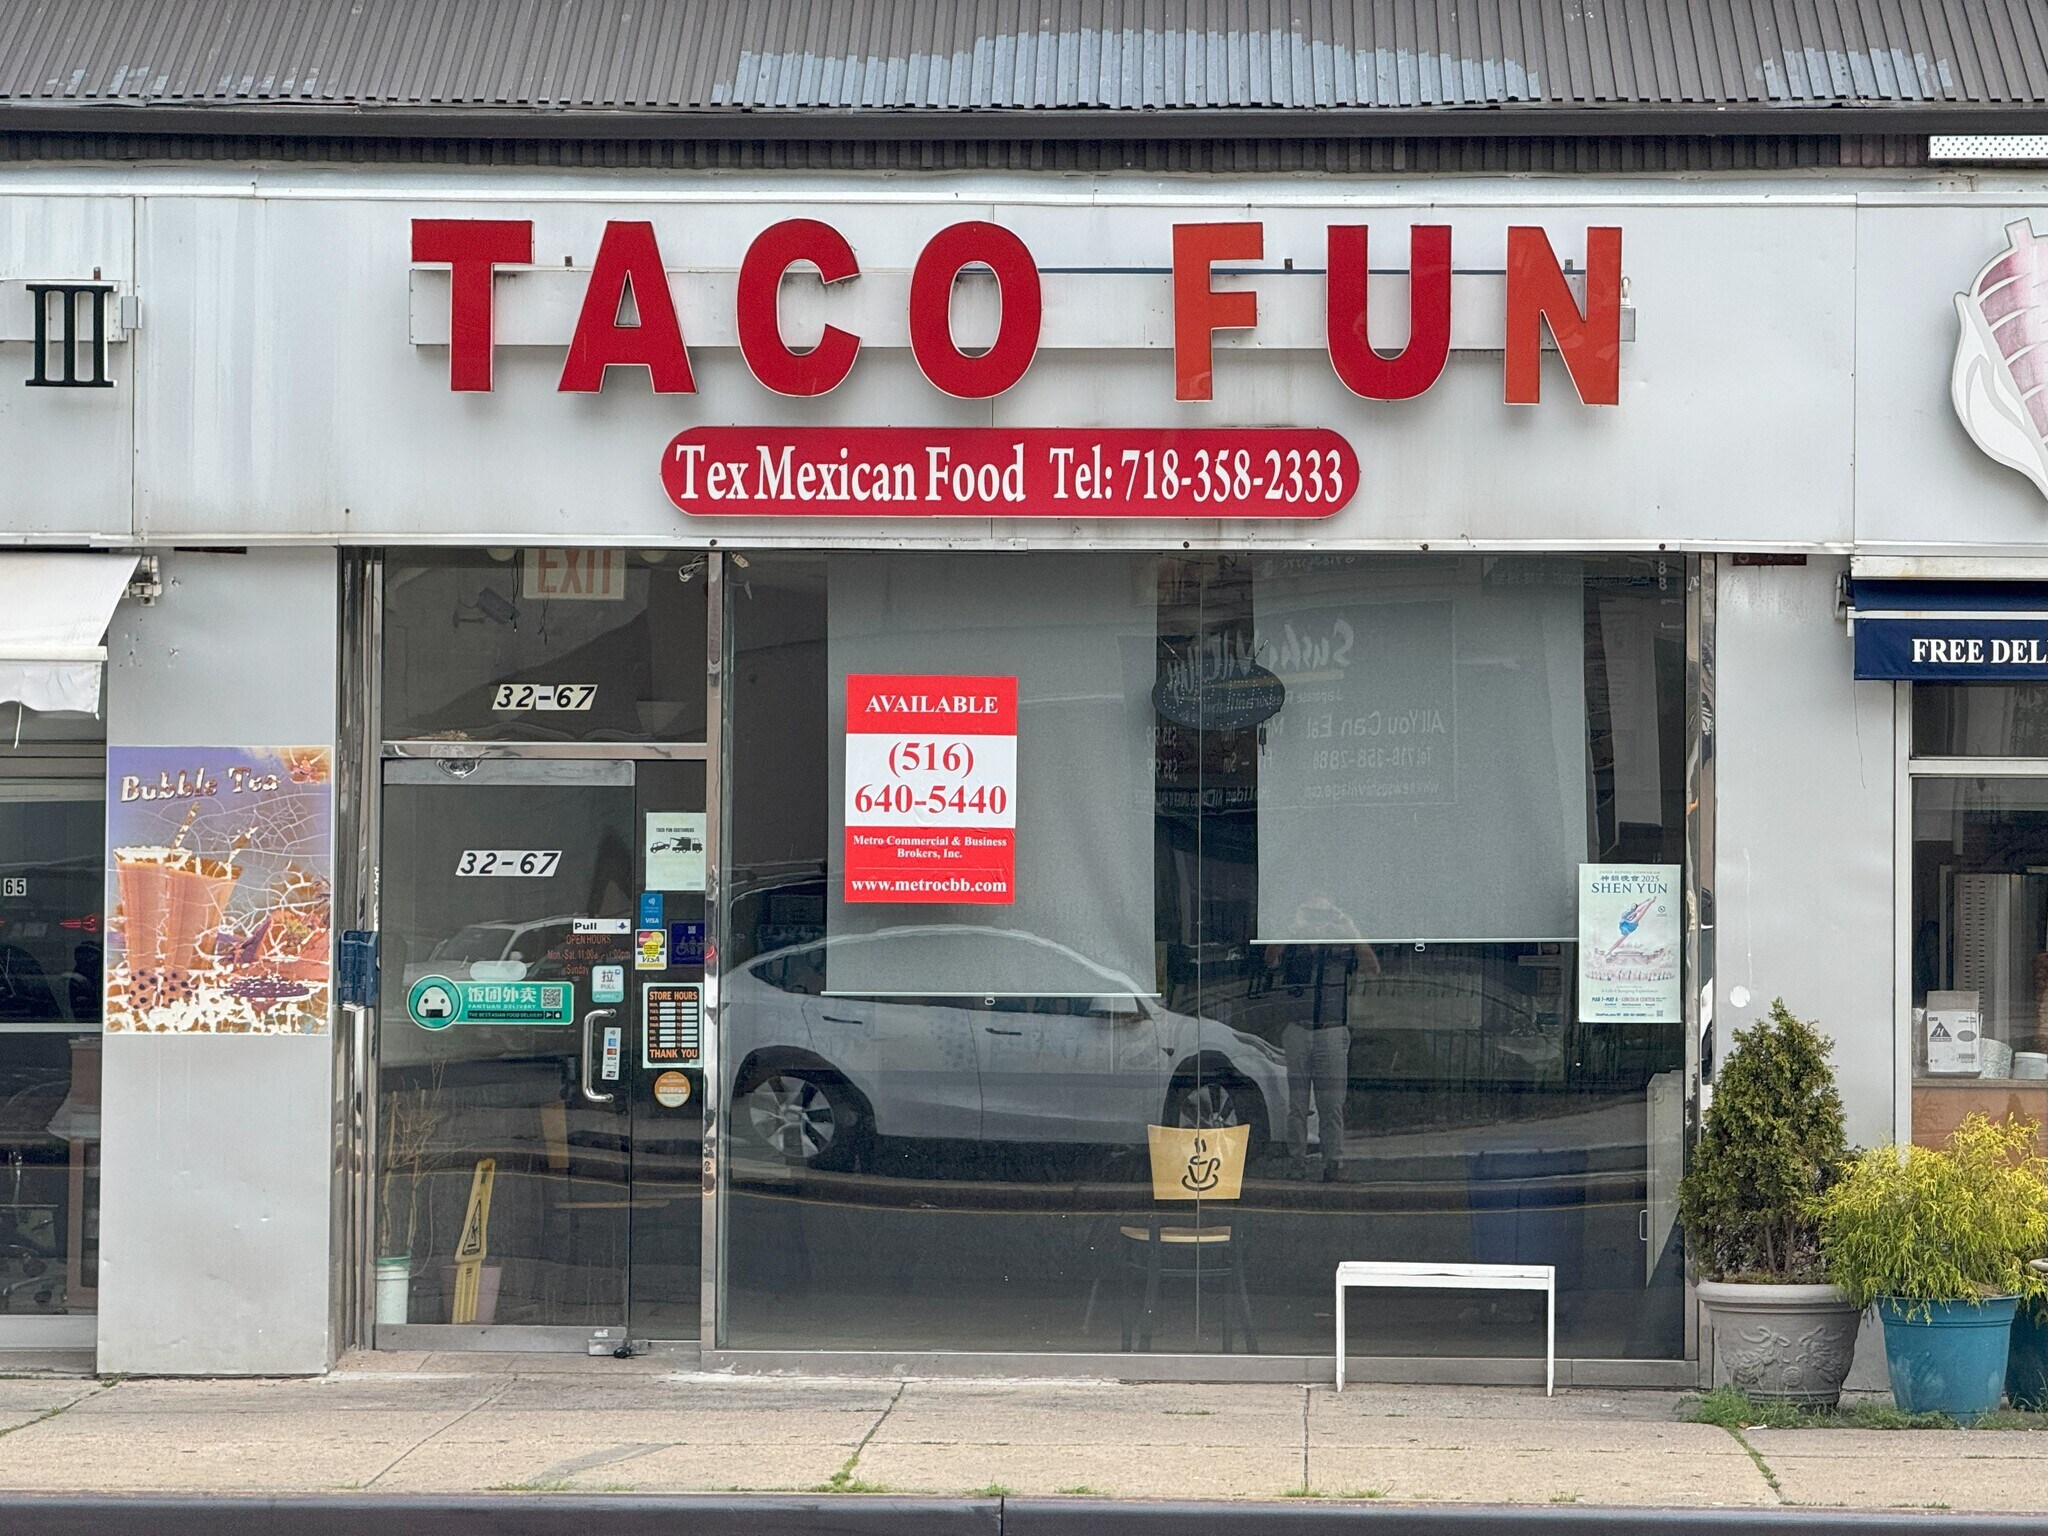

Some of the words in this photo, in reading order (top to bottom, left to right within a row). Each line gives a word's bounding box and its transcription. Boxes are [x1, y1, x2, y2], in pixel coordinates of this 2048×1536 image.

[410, 217, 1043, 399] TACO
[1172, 221, 1623, 405] FUN
[675, 444, 749, 500] Tex
[754, 445, 918, 502] Mexican
[924, 443, 1026, 502] Food
[1049, 444, 1113, 500] Tel:
[1121, 449, 1343, 503] 718-358-2333
[1912, 639, 1984, 663] FREE
[1991, 639, 2048, 664] DEL
[497, 686, 595, 708] 32-67
[865, 695, 999, 714] AVAILABLE
[888, 741, 975, 779] (516)
[120, 767, 217, 803] Bubble
[228, 767, 280, 794] Tea
[854, 784, 1007, 814] 640-5440
[853, 836, 885, 846] Metro
[887, 836, 949, 846] Commercial
[951, 837, 960, 846] &
[965, 837, 1007, 847] Business
[897, 848, 941, 859] Brokers,
[943, 849, 963, 859] Inc.
[461, 853, 558, 875] 32-67
[5, 879, 25, 895] 65
[851, 878, 1007, 892] www.metrocbb.com
[1591, 882, 1632, 893] SHEN
[1637, 883, 1668, 894] YUN
[574, 922, 597, 930] Pull
[566, 934, 586, 945] OPEN
[587, 934, 611, 944] HOURS
[641, 955, 660, 963] VISA
[602, 970, 614, 982] 拉
[468, 986, 537, 1003] 饭团外卖
[649, 991, 672, 1000] STORE
[674, 991, 698, 1000] HOURS
[650, 1049, 678, 1058] THANK
[681, 1049, 698, 1058] YOU
